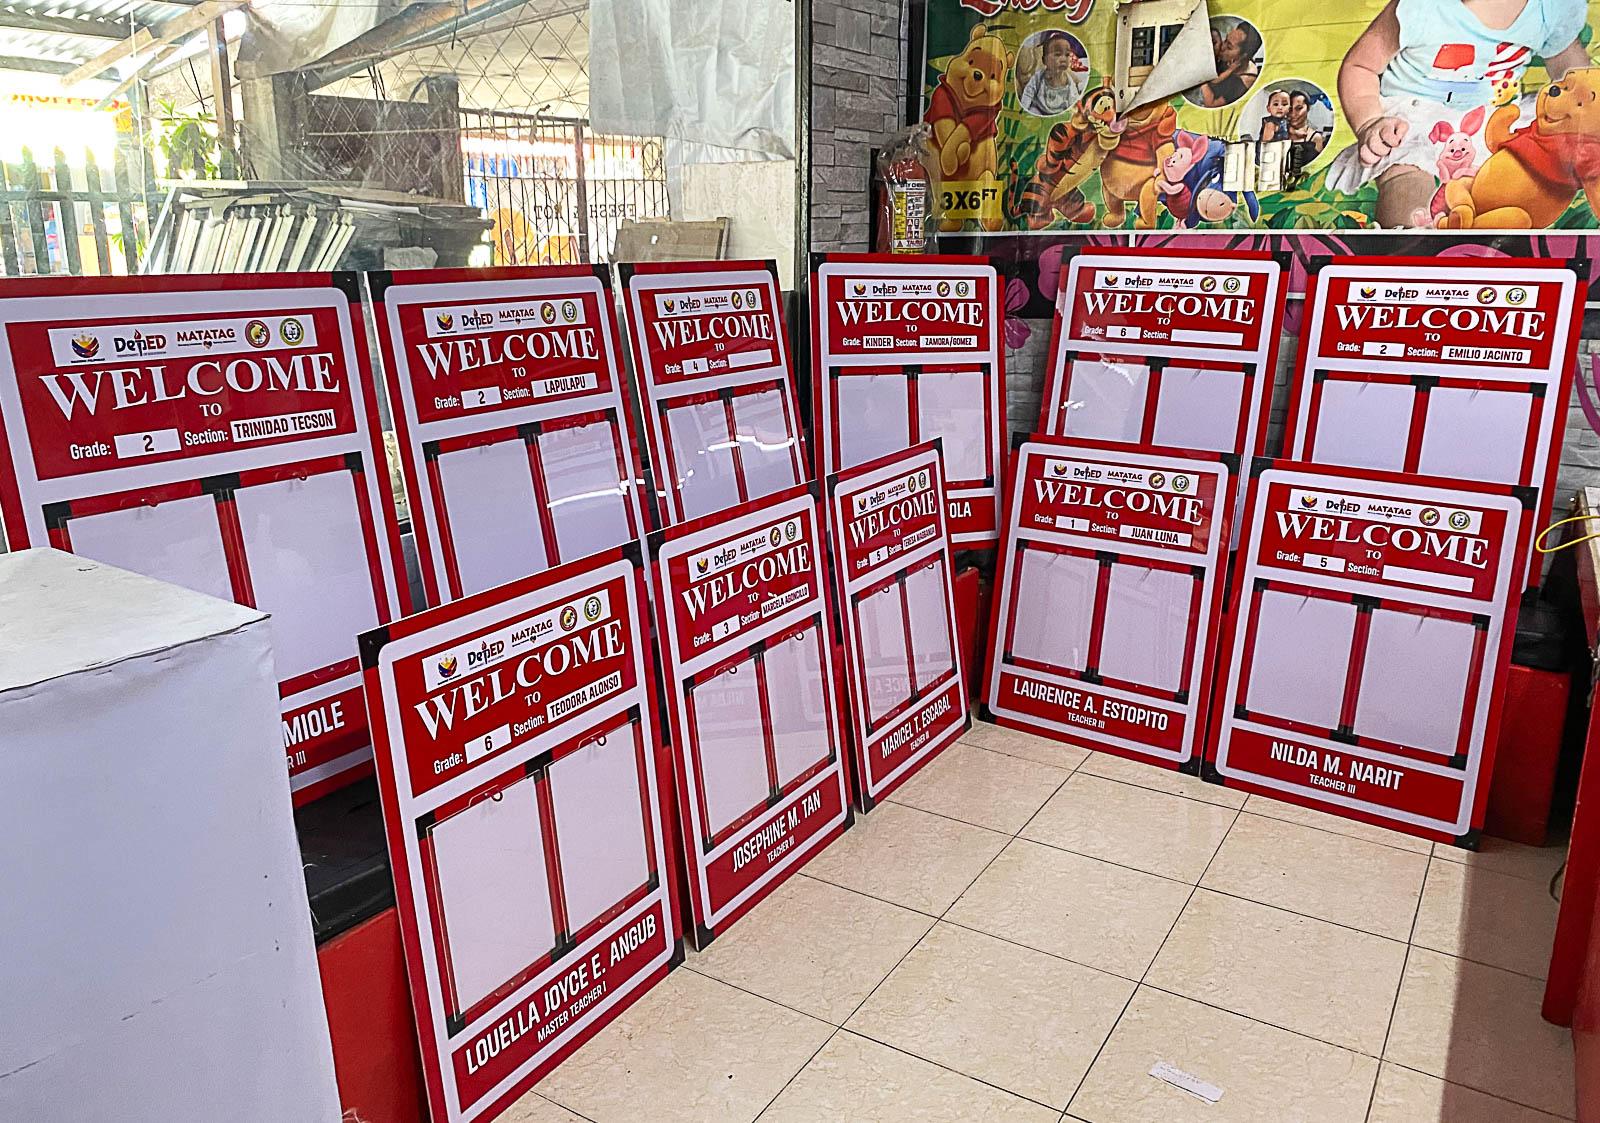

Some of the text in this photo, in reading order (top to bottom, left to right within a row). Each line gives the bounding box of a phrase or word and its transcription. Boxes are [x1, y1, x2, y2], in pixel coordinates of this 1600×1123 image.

[704, 296, 728, 306] MATATAG
[1384, 286, 1470, 301] DepED MATATAG
[461, 308, 535, 330] DepED MATATAG
[835, 301, 984, 327] WELCOME
[1083, 291, 1255, 325] WELCOME
[652, 313, 774, 351] WELCOME
[1084, 325, 1169, 340] Grade: 6 Section:
[1157, 317, 1171, 326] TO
[1335, 304, 1546, 341] WELCOME
[114, 328, 236, 357] DepED MATATAG
[714, 342, 725, 353] TO
[865, 337, 892, 347] KINDER
[925, 337, 972, 347] ZAMORA/GOMEZ
[1424, 332, 1441, 342] TO
[416, 327, 600, 380] WELCOME
[1337, 342, 1523, 361] Grade: 2 Section: EMILIO JACINTO
[511, 366, 526, 378] TO
[664, 359, 728, 375] Grade: 4 Section:
[39, 353, 340, 422] WELCOME
[434, 377, 587, 410] Grade: 2 Section: LAPULAPU
[200, 403, 223, 418] TO
[70, 411, 334, 461] Grade: 2 Section: TRINIDAD TECSON
[1107, 470, 1143, 480] MATATAG
[1033, 479, 1204, 526] WELCOME
[1105, 510, 1119, 520] TO
[1326, 498, 1361, 514] DepED
[1367, 504, 1412, 516] MATATAG
[848, 490, 937, 548] WELCOME
[1034, 513, 1179, 544] Grade: 1 Section: JUAN LUNA
[892, 528, 901, 538] TO
[1275, 511, 1489, 569] WELCOME
[1276, 550, 1380, 577] Grade: 5 Section:
[1365, 549, 1382, 560] TO
[681, 542, 811, 621] WELCOME
[747, 592, 760, 604] TO
[723, 622, 729, 634] 3
[467, 640, 505, 665] DepED
[511, 619, 553, 643] MATATAG
[414, 619, 625, 741] WELCOME
[525, 691, 541, 707] TO
[1013, 678, 1169, 731] LAURENCE A. ESTOPITO
[434, 674, 619, 774] Grade: 6 Section: TEODORA ALONSO
[881, 694, 951, 759] MARICEL T. ESCABAL
[1067, 712, 1098, 728] TEACHER
[295, 750, 307, 766] III
[1270, 741, 1404, 790] NILDA M. NARIT
[1309, 773, 1356, 794] TEACHER III
[733, 790, 821, 873] JOSEPHINE M. TAN
[766, 839, 790, 863] TEACHER
[465, 913, 656, 1076] LOUELLA JOYCE E. ANGUB
[536, 980, 608, 1044] MASTER TEACHER I
